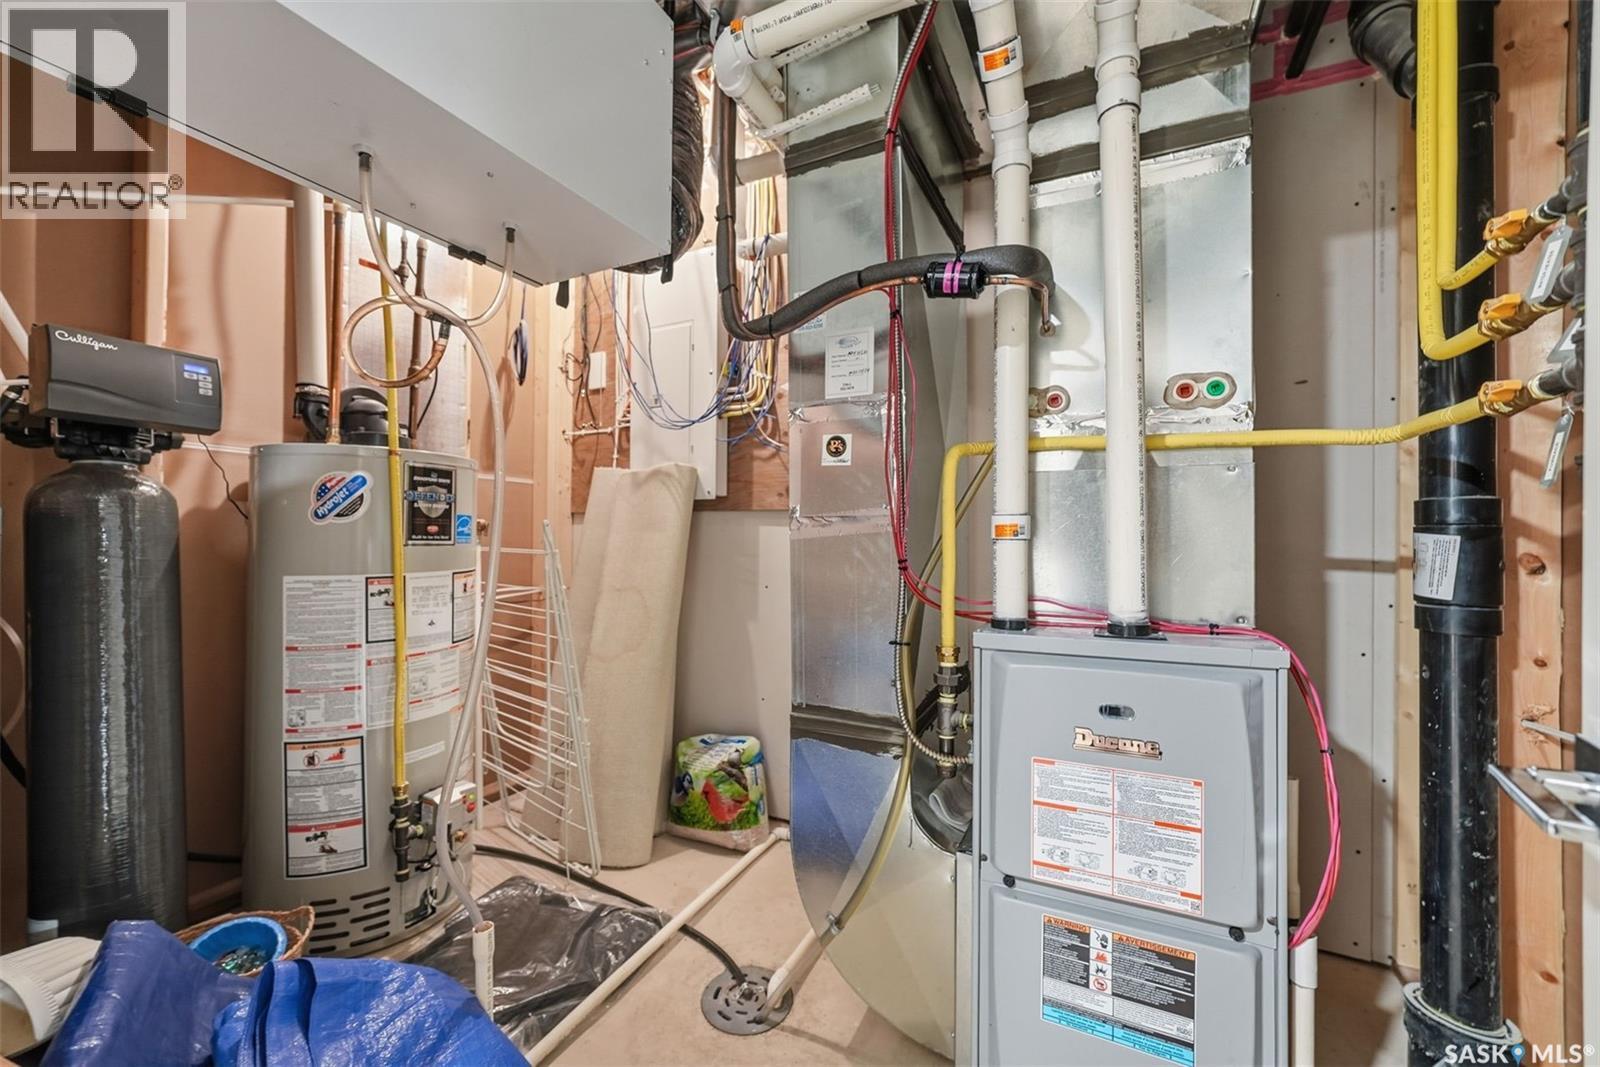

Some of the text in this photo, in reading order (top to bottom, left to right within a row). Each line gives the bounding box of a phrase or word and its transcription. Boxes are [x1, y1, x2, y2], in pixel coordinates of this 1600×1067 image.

[54, 329, 118, 351] Culligan
[315, 487, 349, 517] Hydrojet
[1073, 726, 1161, 756] Ducane
[1053, 919, 1088, 932] WARNING
[1125, 937, 1191, 959] AVERTISSEMENT
